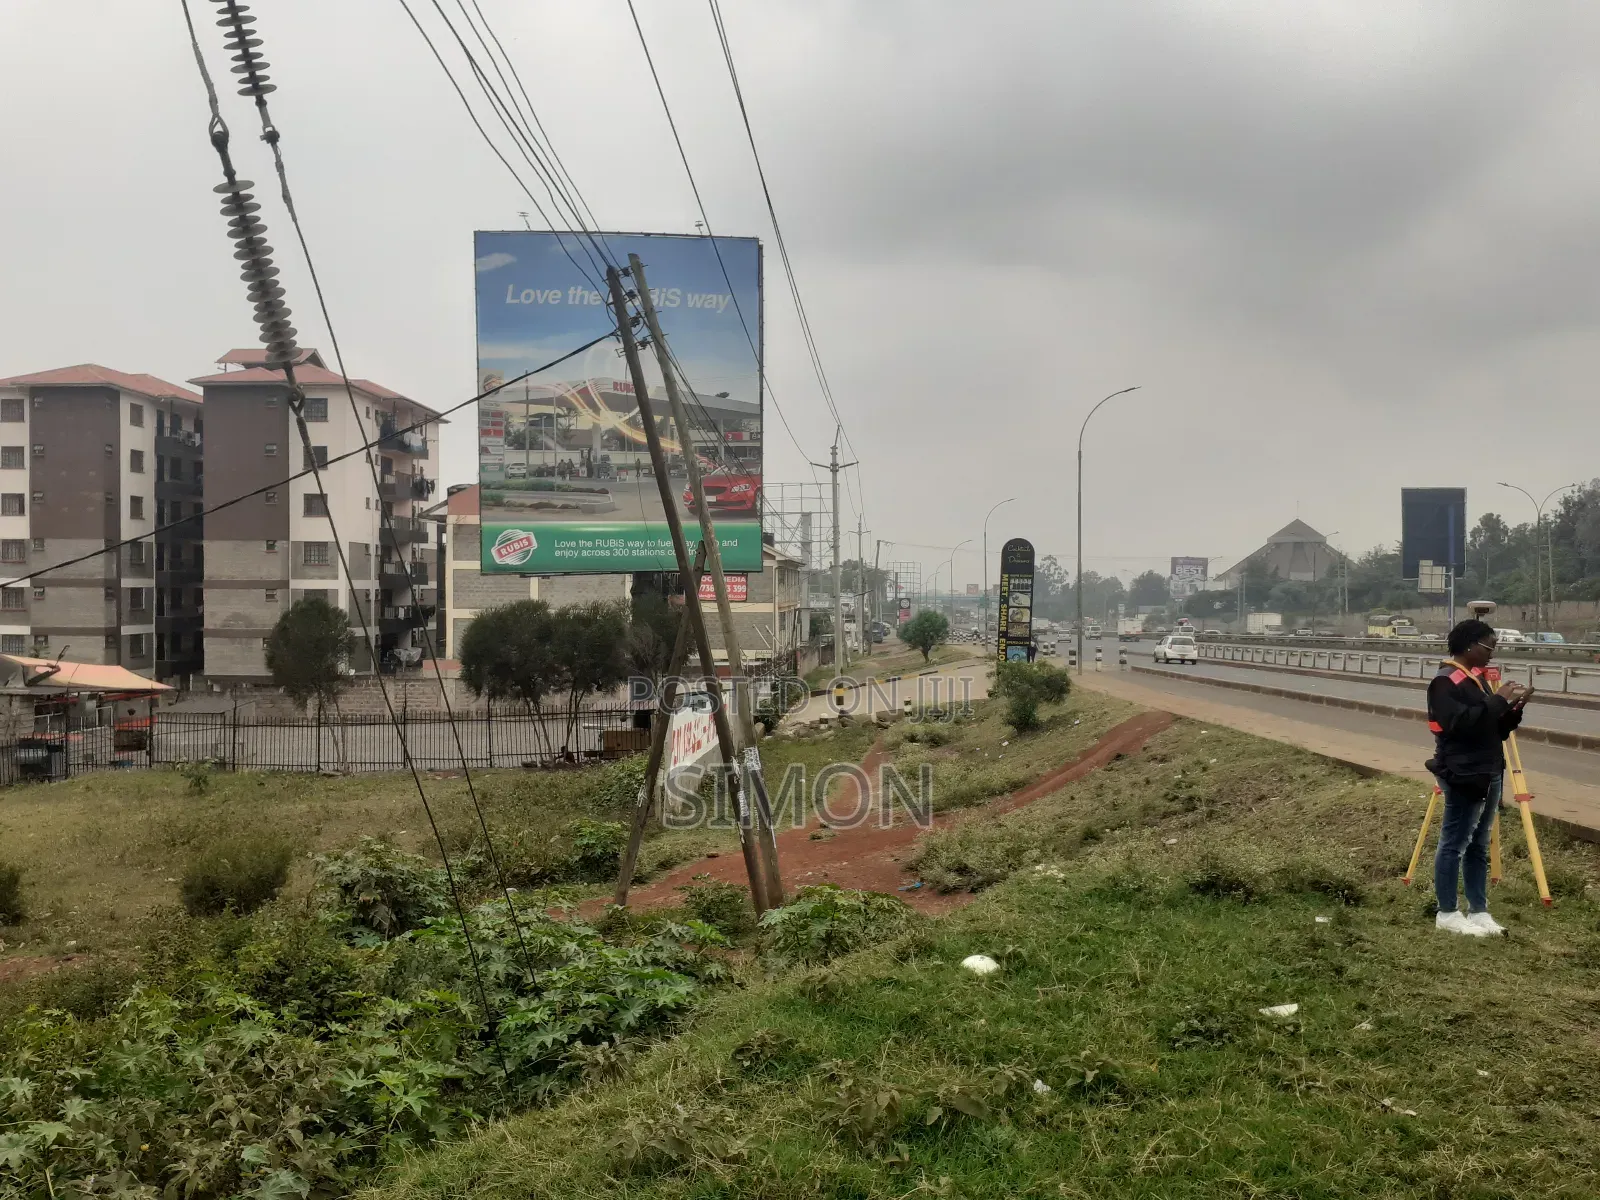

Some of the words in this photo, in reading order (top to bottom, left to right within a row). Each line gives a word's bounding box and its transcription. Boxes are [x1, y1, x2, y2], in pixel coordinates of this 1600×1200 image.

[506, 284, 561, 305] Love
[568, 286, 602, 305] the
[687, 292, 733, 313] way
[500, 539, 529, 556] RUBIS
[554, 539, 576, 548] Love
[579, 539, 593, 548] the
[595, 539, 625, 548] RUBiS
[627, 541, 645, 550] way
[647, 540, 656, 548] to
[722, 539, 738, 548] and
[554, 549, 579, 559] enjoy
[581, 549, 611, 557] across
[613, 548, 630, 557] 300
[631, 548, 666, 557] stations
[1175, 564, 1204, 575] BEST
[733, 584, 746, 592] 399
